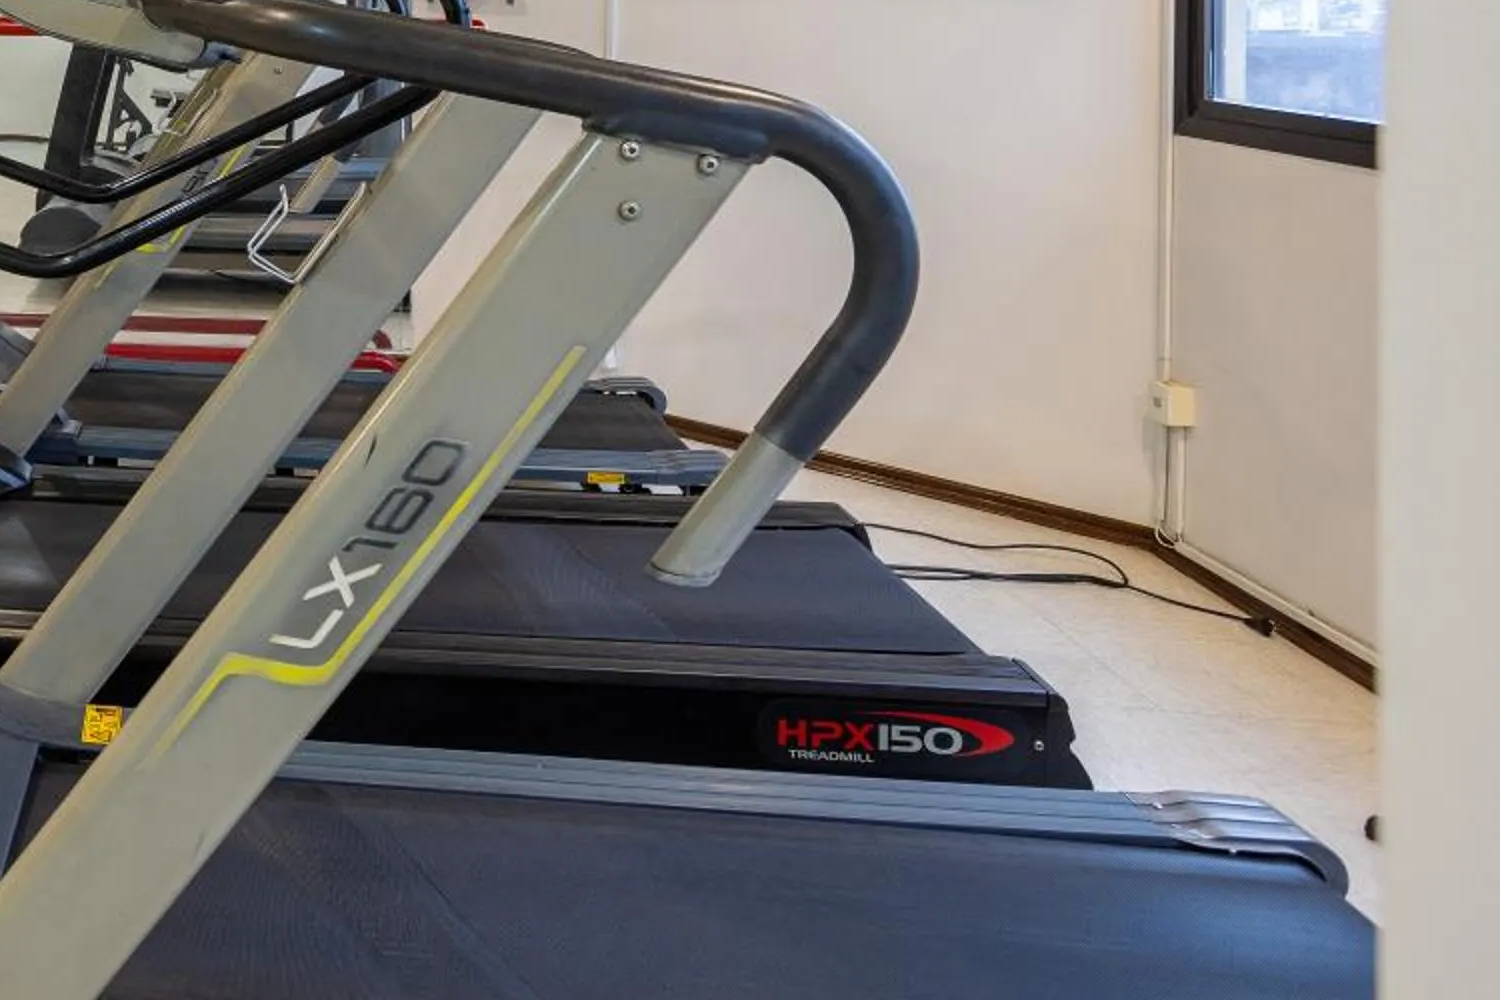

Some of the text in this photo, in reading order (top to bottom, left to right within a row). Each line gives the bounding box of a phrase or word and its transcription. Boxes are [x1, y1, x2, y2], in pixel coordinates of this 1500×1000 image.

[268, 439, 467, 649] LX160
[776, 716, 963, 755] HPX150
[789, 748, 875, 763] TREADMILL
